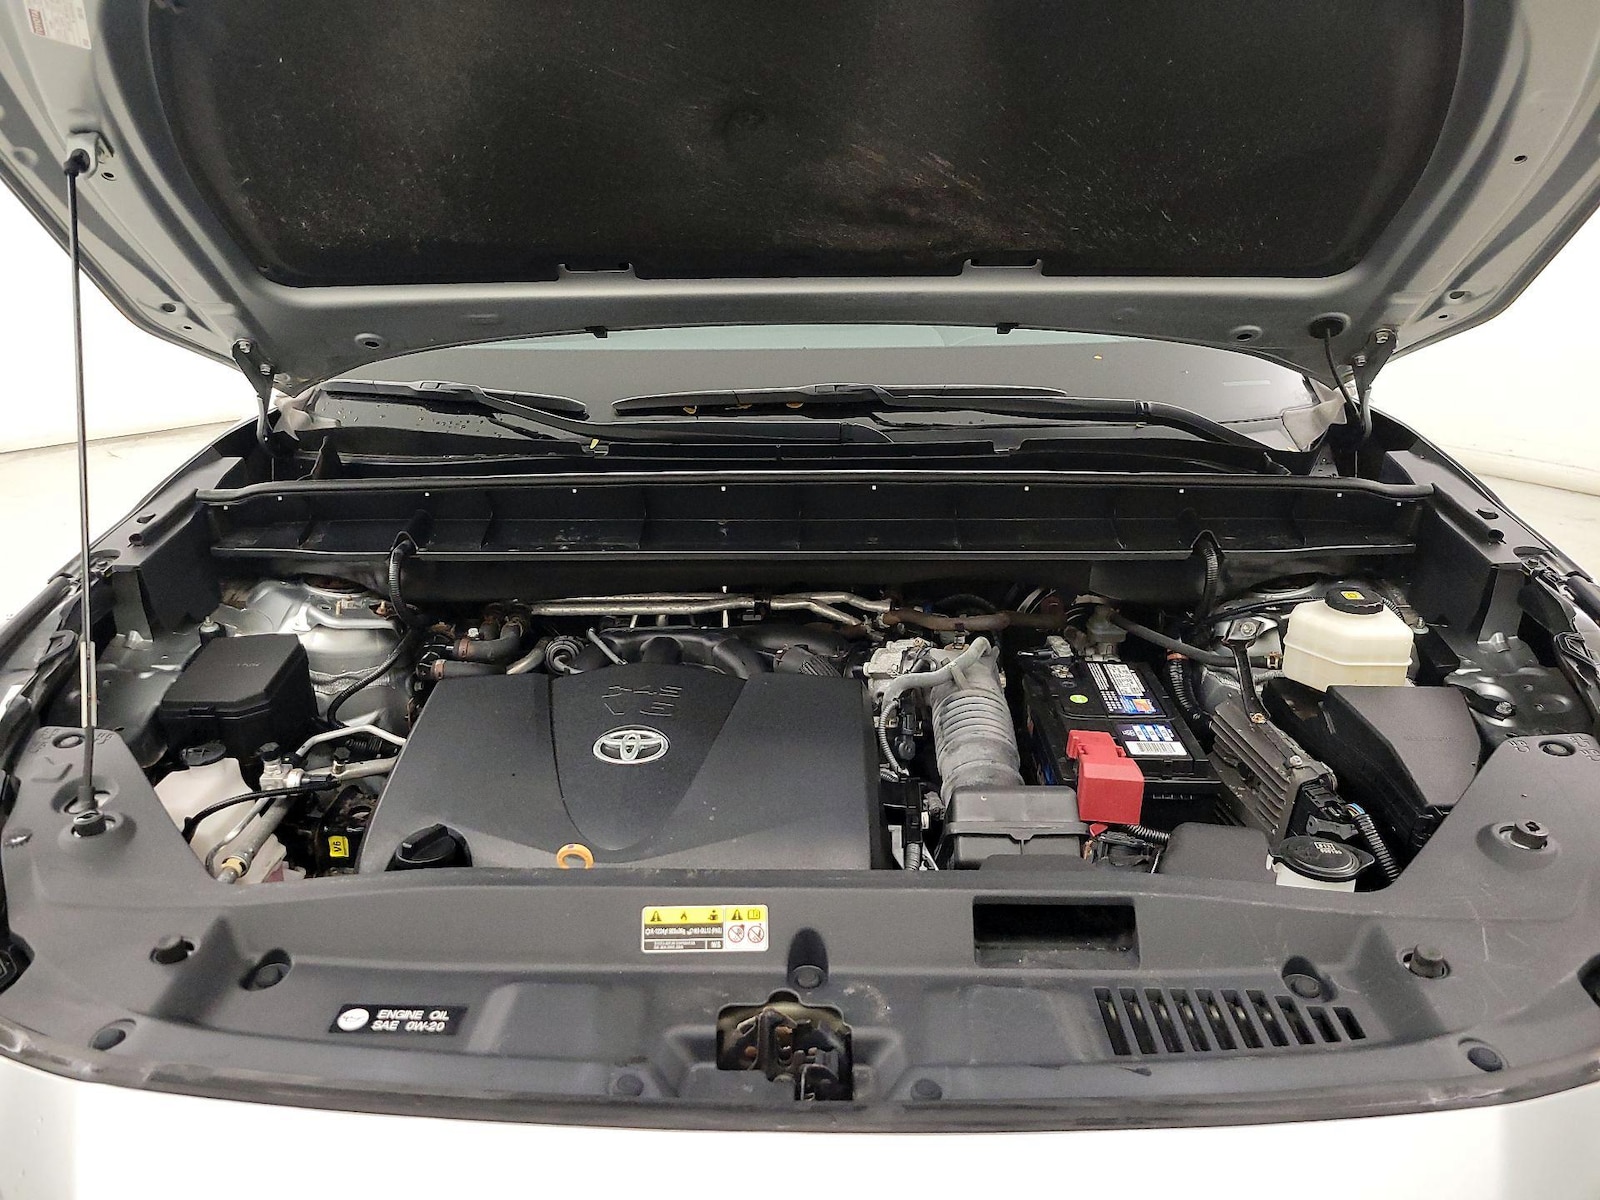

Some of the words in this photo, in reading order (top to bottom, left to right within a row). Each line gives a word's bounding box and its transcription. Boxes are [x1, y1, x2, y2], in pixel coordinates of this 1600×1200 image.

[376, 1009, 424, 1020] ENGINE
[428, 1010, 449, 1021] OIL
[370, 1020, 400, 1031] SAE
[404, 1021, 446, 1032] 0W-20
